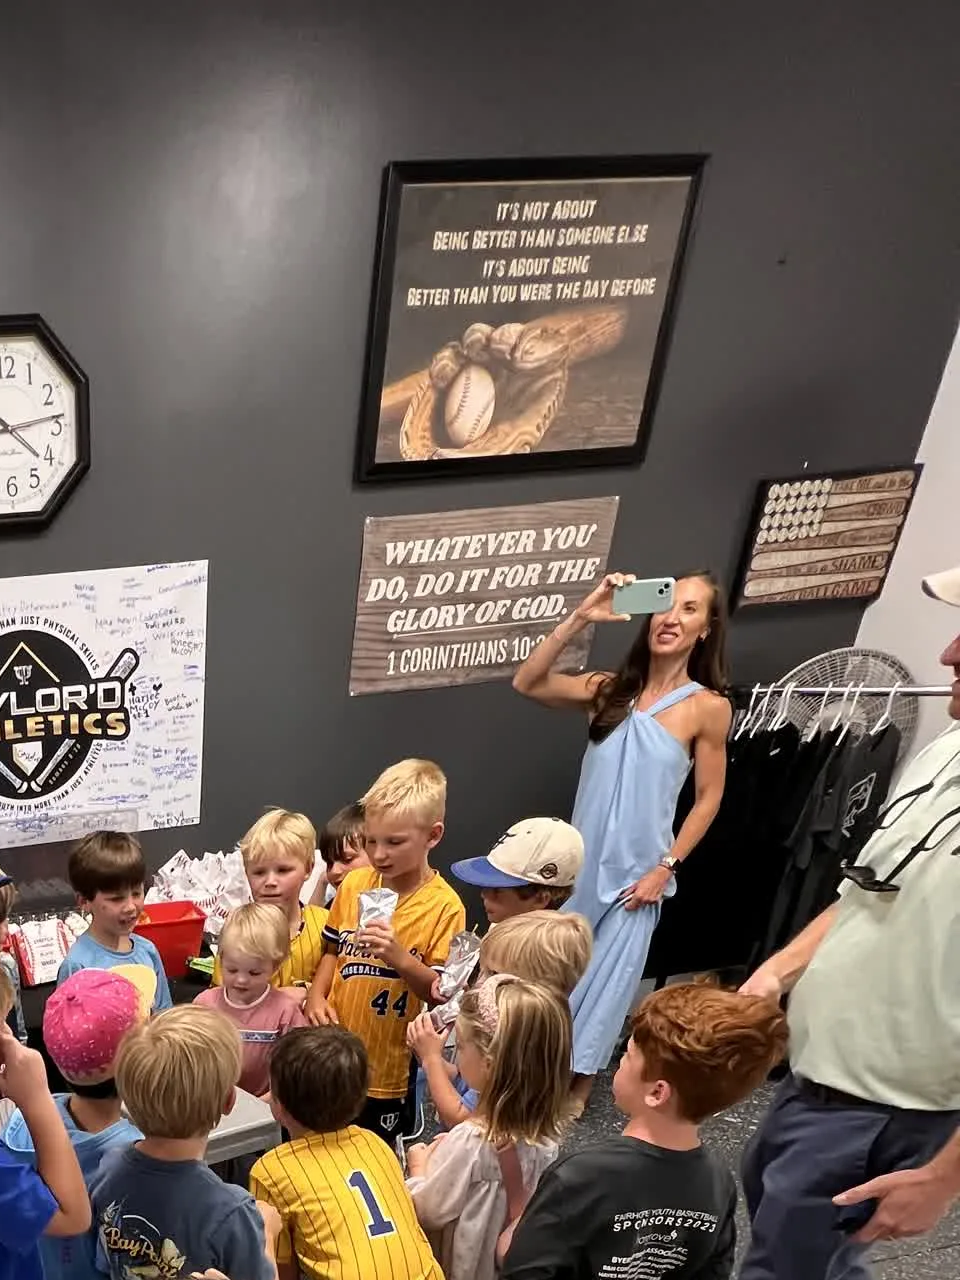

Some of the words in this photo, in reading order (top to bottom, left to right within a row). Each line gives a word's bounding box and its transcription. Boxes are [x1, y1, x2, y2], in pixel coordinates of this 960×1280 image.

[496, 202, 518, 222] IT'S
[522, 202, 549, 221] NOT
[552, 200, 597, 219] ABOUT
[433, 231, 470, 250] BEING
[472, 230, 516, 249] BETTER
[519, 228, 554, 248] THAN
[556, 225, 616, 246] SOMEONE
[617, 224, 649, 243] ELSE
[483, 260, 505, 278] IT'S
[508, 256, 550, 277] ABOUT
[552, 255, 590, 274] BEING
[407, 287, 450, 306] BETTER
[453, 286, 489, 305] THAN
[492, 285, 517, 303] YOU
[520, 284, 552, 301] WERE
[556, 282, 579, 299] THE
[583, 280, 610, 297] DAY
[611, 278, 657, 296] BEFORE
[26, 362, 33, 385] 1
[42, 383, 54, 406] 2
[50, 414, 62, 436] 3
[43, 444, 55, 466] 4
[6, 476, 18, 497] 6
[29, 468, 40, 489] 5
[385, 529, 537, 566] WHATEVER
[541, 523, 597, 551] YOU
[365, 576, 409, 603] DO,
[413, 572, 454, 598] DO
[455, 567, 489, 594] IT
[488, 563, 541, 590] FOR
[546, 557, 601, 584] THE
[386, 603, 475, 633] GLORY
[474, 600, 512, 624] OF
[511, 594, 568, 621] GOD.
[21, 616, 40, 625] JUST
[43, 617, 79, 645] PHYSICAL
[386, 650, 396, 676] 1
[399, 638, 508, 674] CORINTHIANS
[511, 635, 546, 663] 10:
[16, 804, 32, 812] INTO
[34, 799, 52, 810] MORE
[53, 790, 69, 803] THAN
[371, 989, 409, 1017] 44
[347, 1169, 395, 1238] 1
[651, 1207, 676, 1217] YOUTH
[675, 1208, 719, 1222] BASKETBALL
[613, 1215, 683, 1232] SPONSORS
[105, 1227, 140, 1256] Bay
